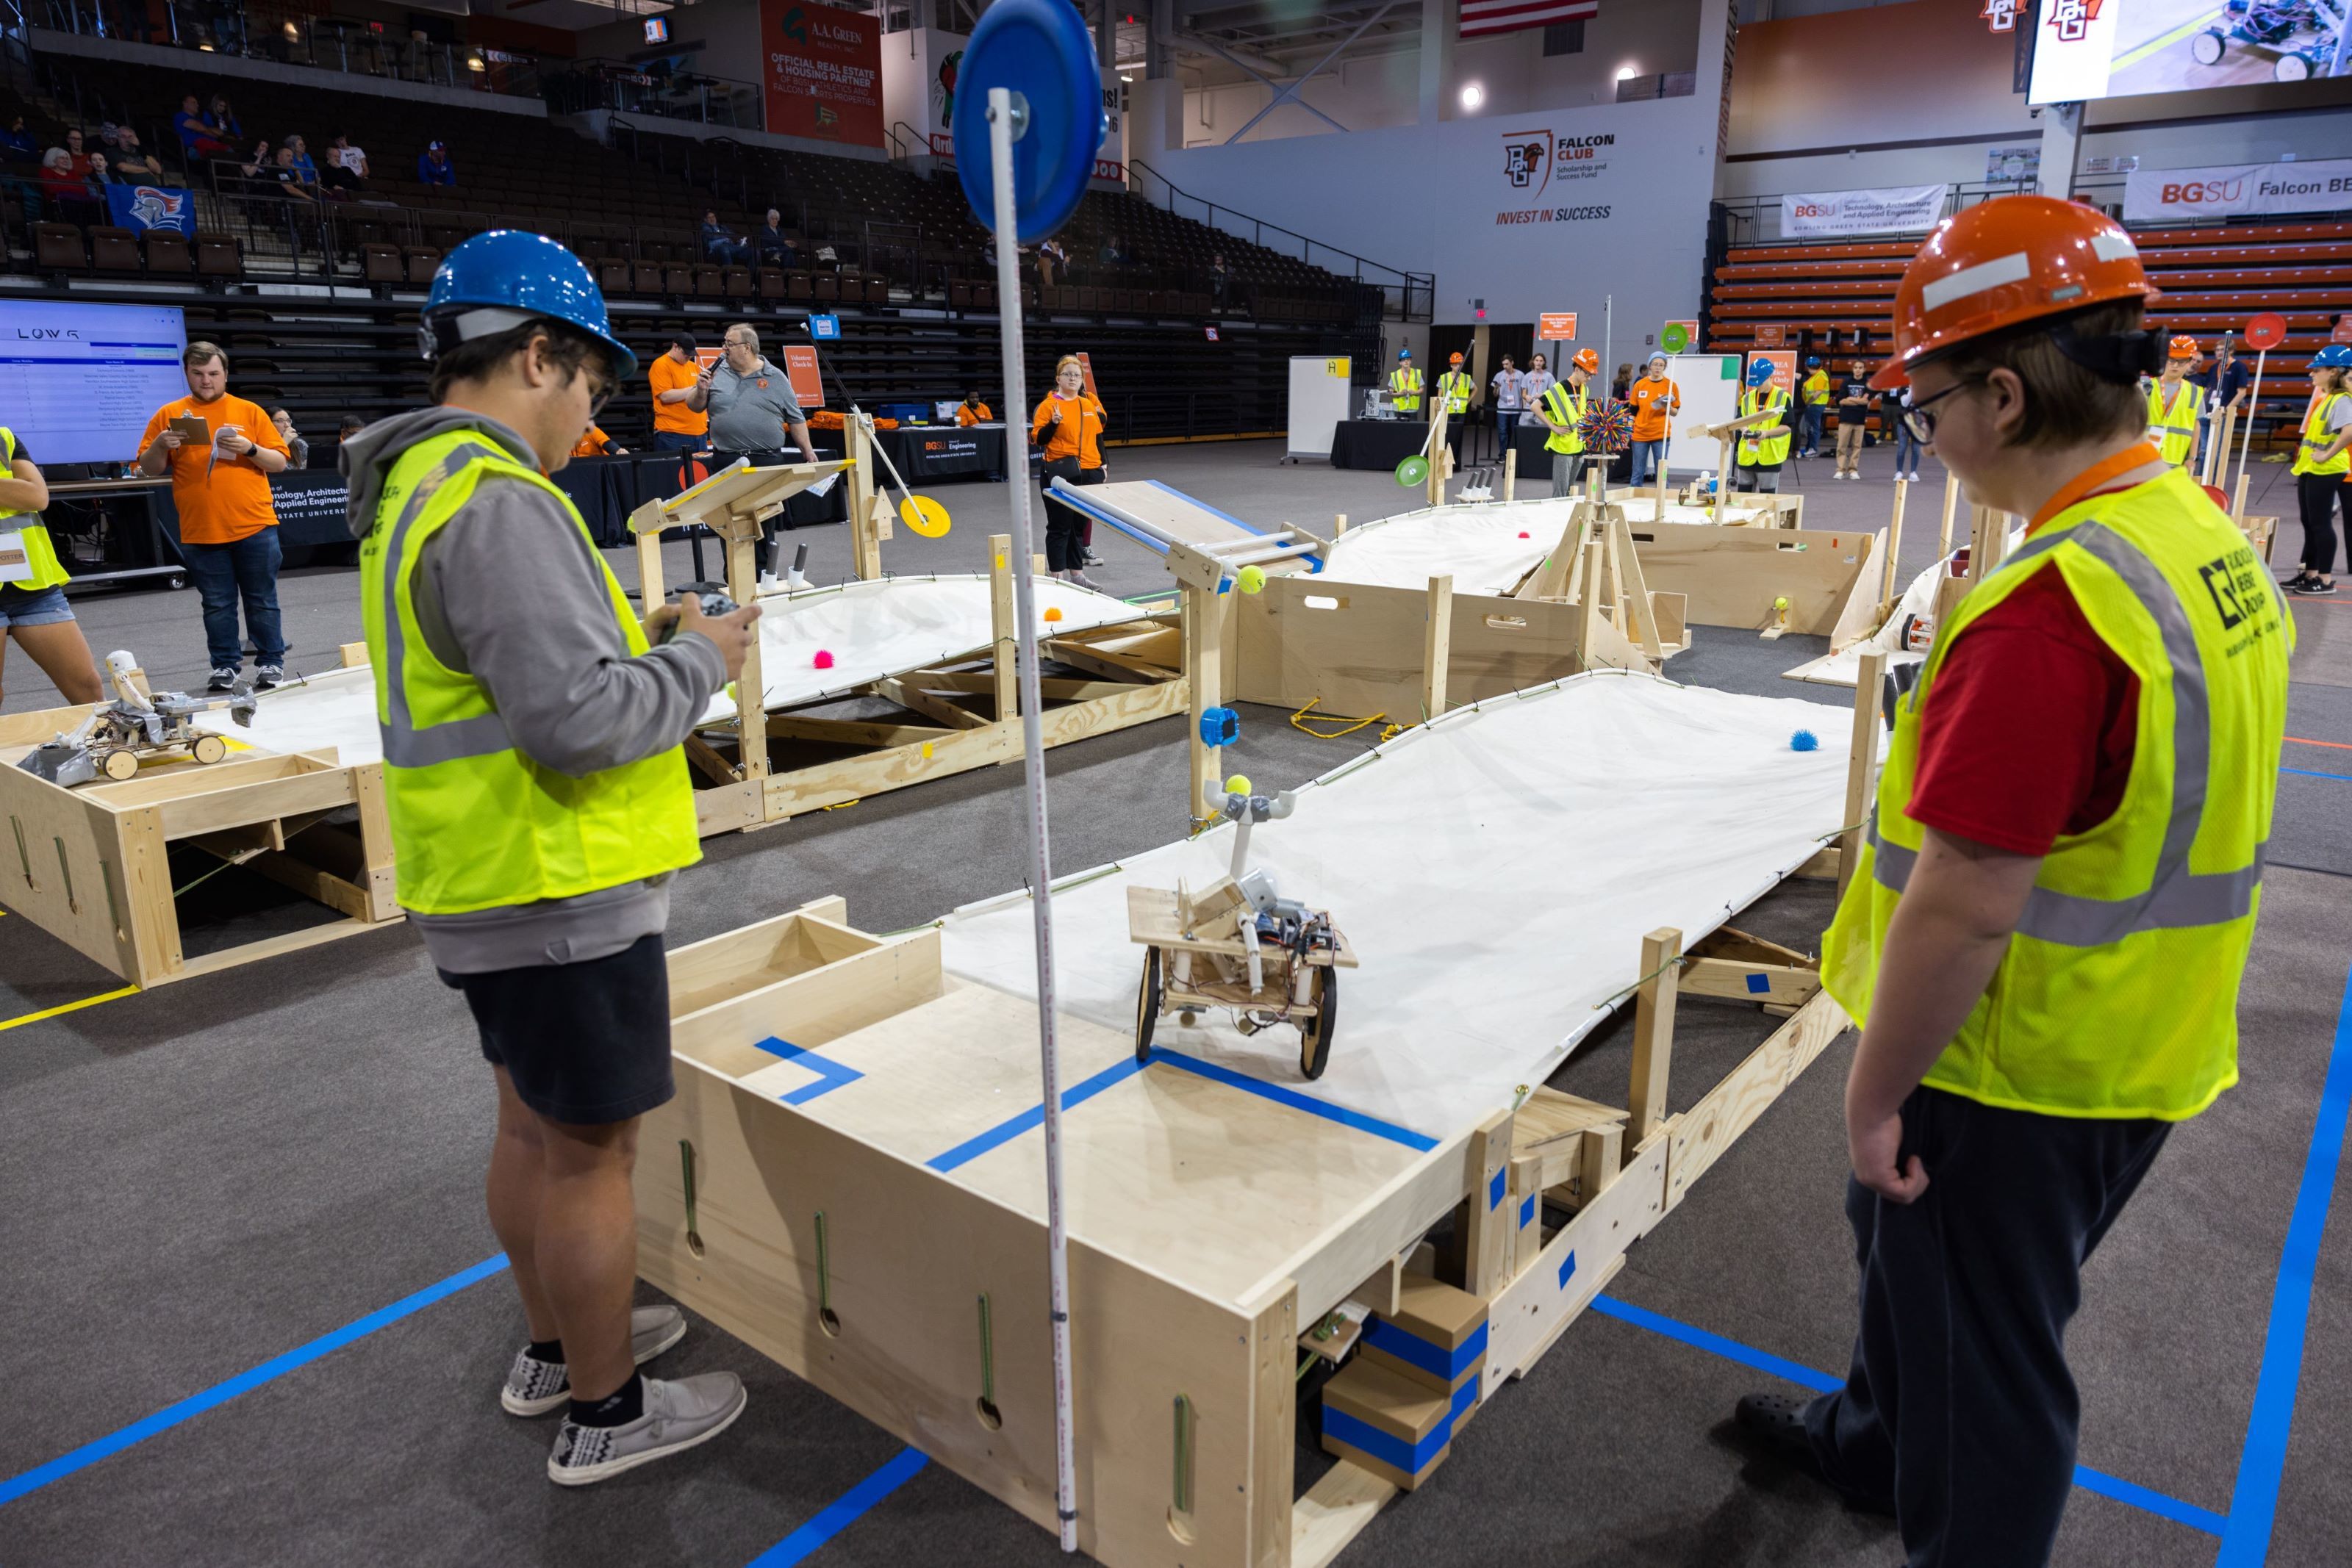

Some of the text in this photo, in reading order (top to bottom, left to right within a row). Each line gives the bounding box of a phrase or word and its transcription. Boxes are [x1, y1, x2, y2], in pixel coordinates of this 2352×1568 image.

[811, 22, 831, 38] A.A.
[771, 52, 875, 79] OFFICIAL REAL ESTATE
[776, 63, 871, 88] & HOUSING PARTNER
[781, 75, 791, 83] OF
[815, 81, 852, 94] ATHLETICS
[853, 87, 869, 96] AND
[773, 82, 803, 95] FALCON
[834, 93, 876, 106] PROPERTIES
[1558, 134, 1615, 149] FALCON
[1557, 148, 1594, 161] CLUB
[1557, 162, 1607, 174] Scholarship and
[1557, 170, 1597, 181] Success Fund
[2161, 180, 2242, 204] BGSU
[2259, 181, 2321, 195] Falcon
[1795, 204, 1835, 218] BGSU
[1843, 201, 1931, 212] Technology, Architecture
[1857, 209, 1885, 219] Applied
[1886, 207, 1930, 218] Engineering
[1496, 206, 1611, 225] INVEST IN SUCCESS
[925, 442, 946, 450] BGSU
[274, 499, 307, 508] Applied
